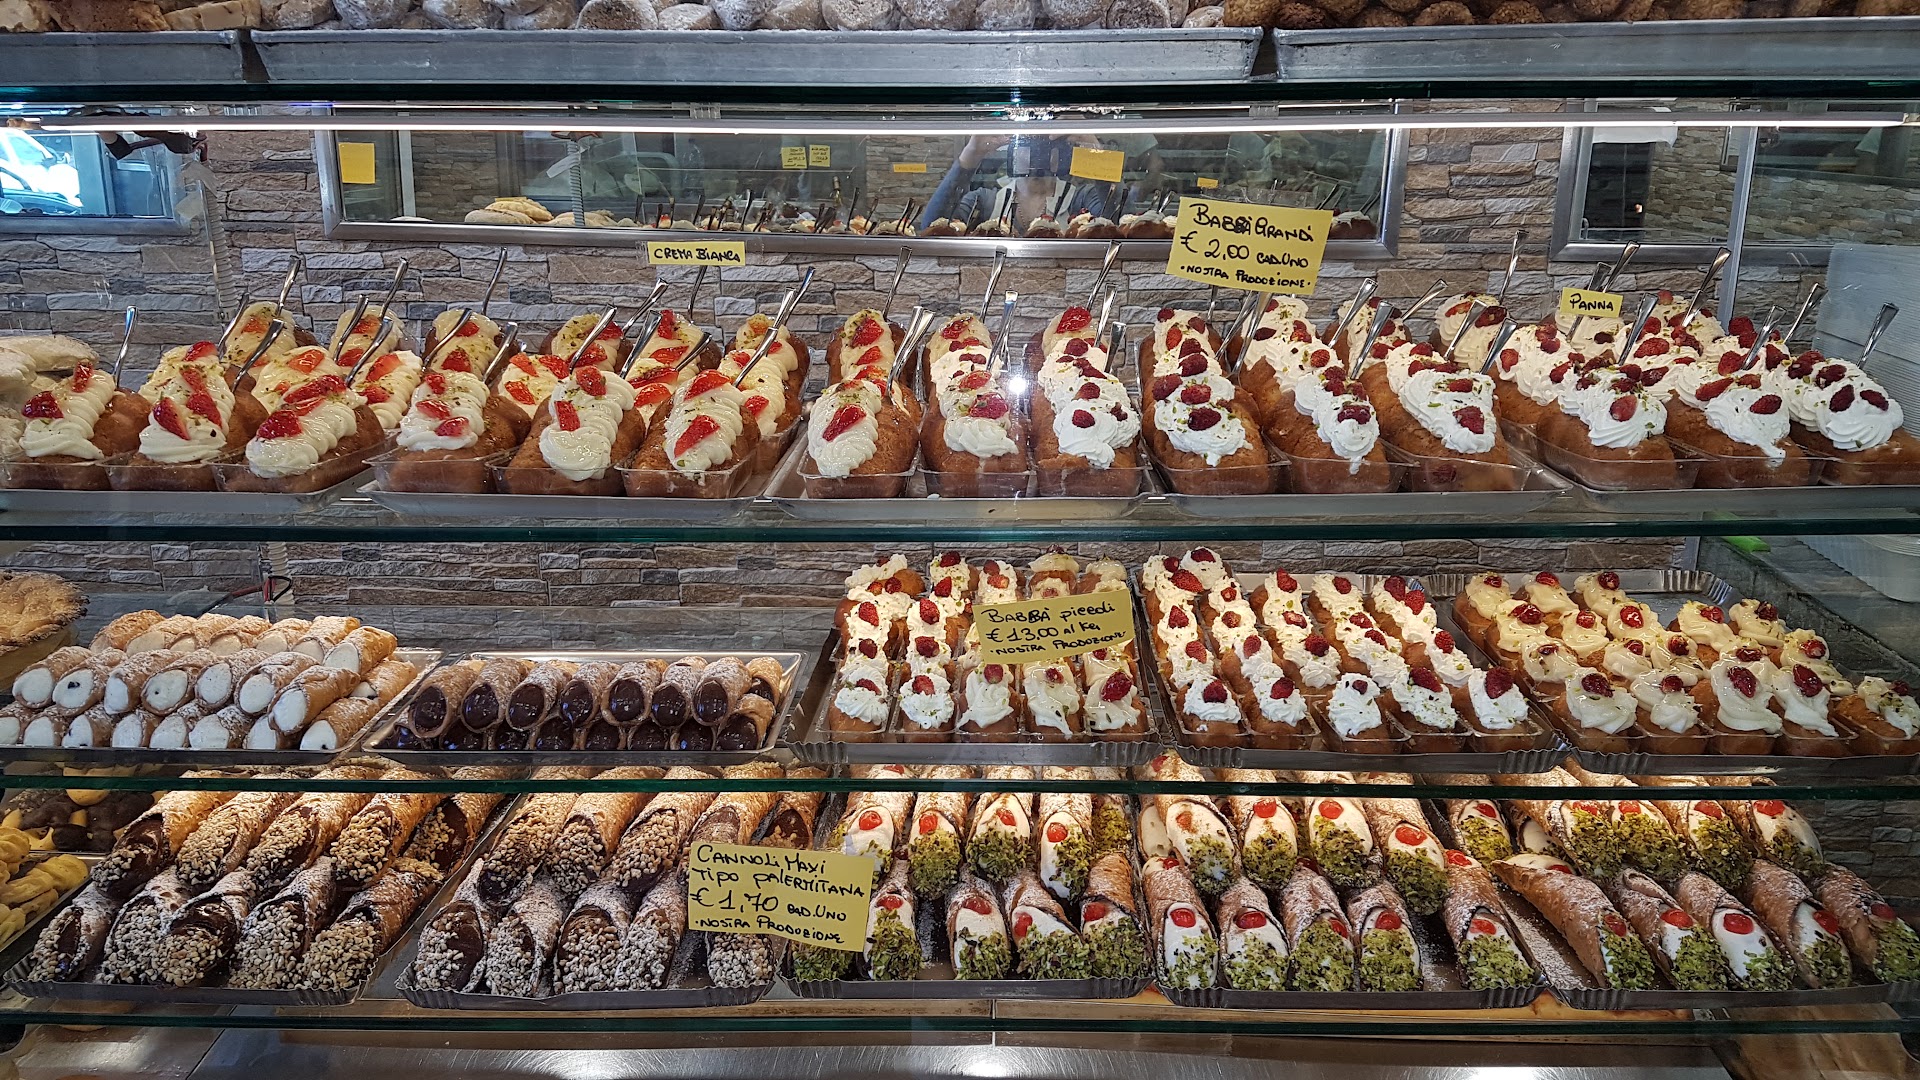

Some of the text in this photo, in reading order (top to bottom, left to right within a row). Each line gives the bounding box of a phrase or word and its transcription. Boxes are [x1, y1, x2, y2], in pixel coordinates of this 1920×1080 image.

[653, 247, 741, 262] CREMA BIANCA
[1180, 230, 1198, 253] €
[1204, 239, 1250, 260] 2,00
[1569, 293, 1614, 311] PANNA
[986, 628, 1003, 643] €
[697, 844, 826, 874] CANNOLI MAXI
[689, 887, 714, 907] €
[718, 890, 779, 913] 1,70
